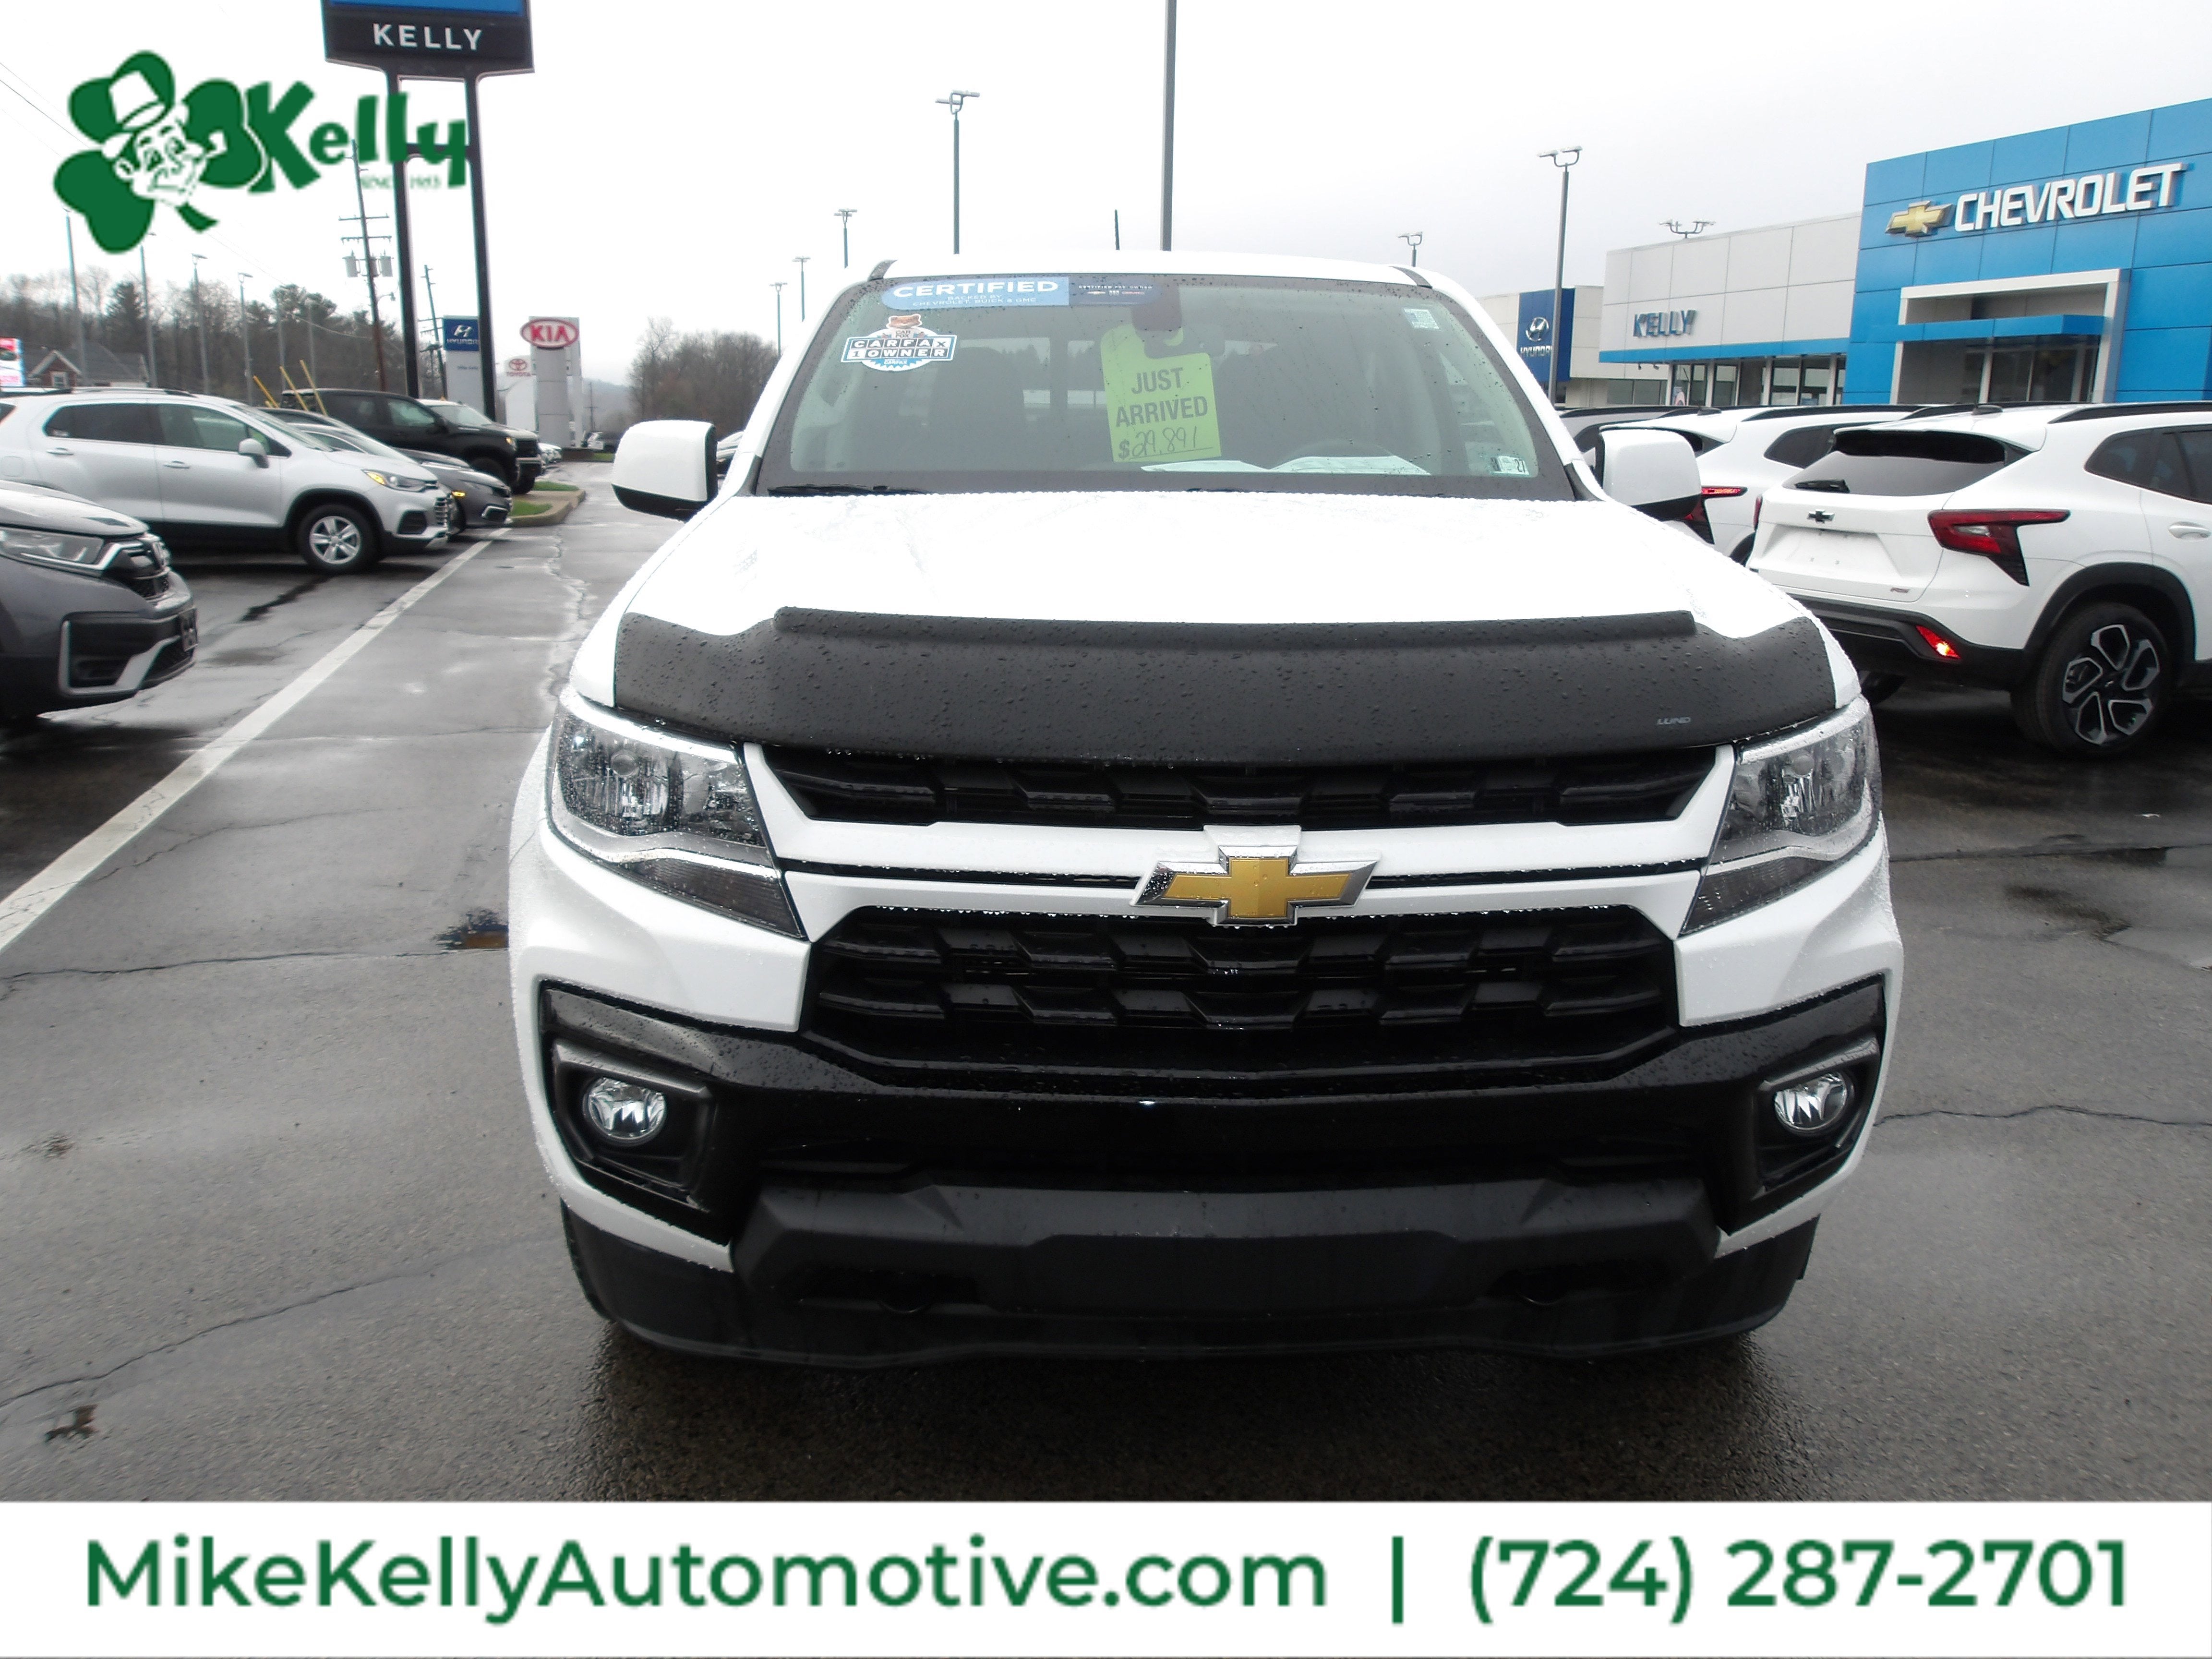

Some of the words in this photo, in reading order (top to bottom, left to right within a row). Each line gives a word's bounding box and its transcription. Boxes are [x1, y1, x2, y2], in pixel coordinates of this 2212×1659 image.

[373, 23, 482, 50] KELLY
[1955, 162, 2187, 232] CHEVROLET
[893, 281, 1058, 297] CERTIFIED
[529, 325, 570, 342] KIA
[1633, 310, 1696, 337] KELLY
[854, 339, 950, 348] CARFAX
[867, 349, 945, 357] OWNER
[1131, 367, 1183, 394] JUST
[1116, 396, 1208, 428] ARRIVED
